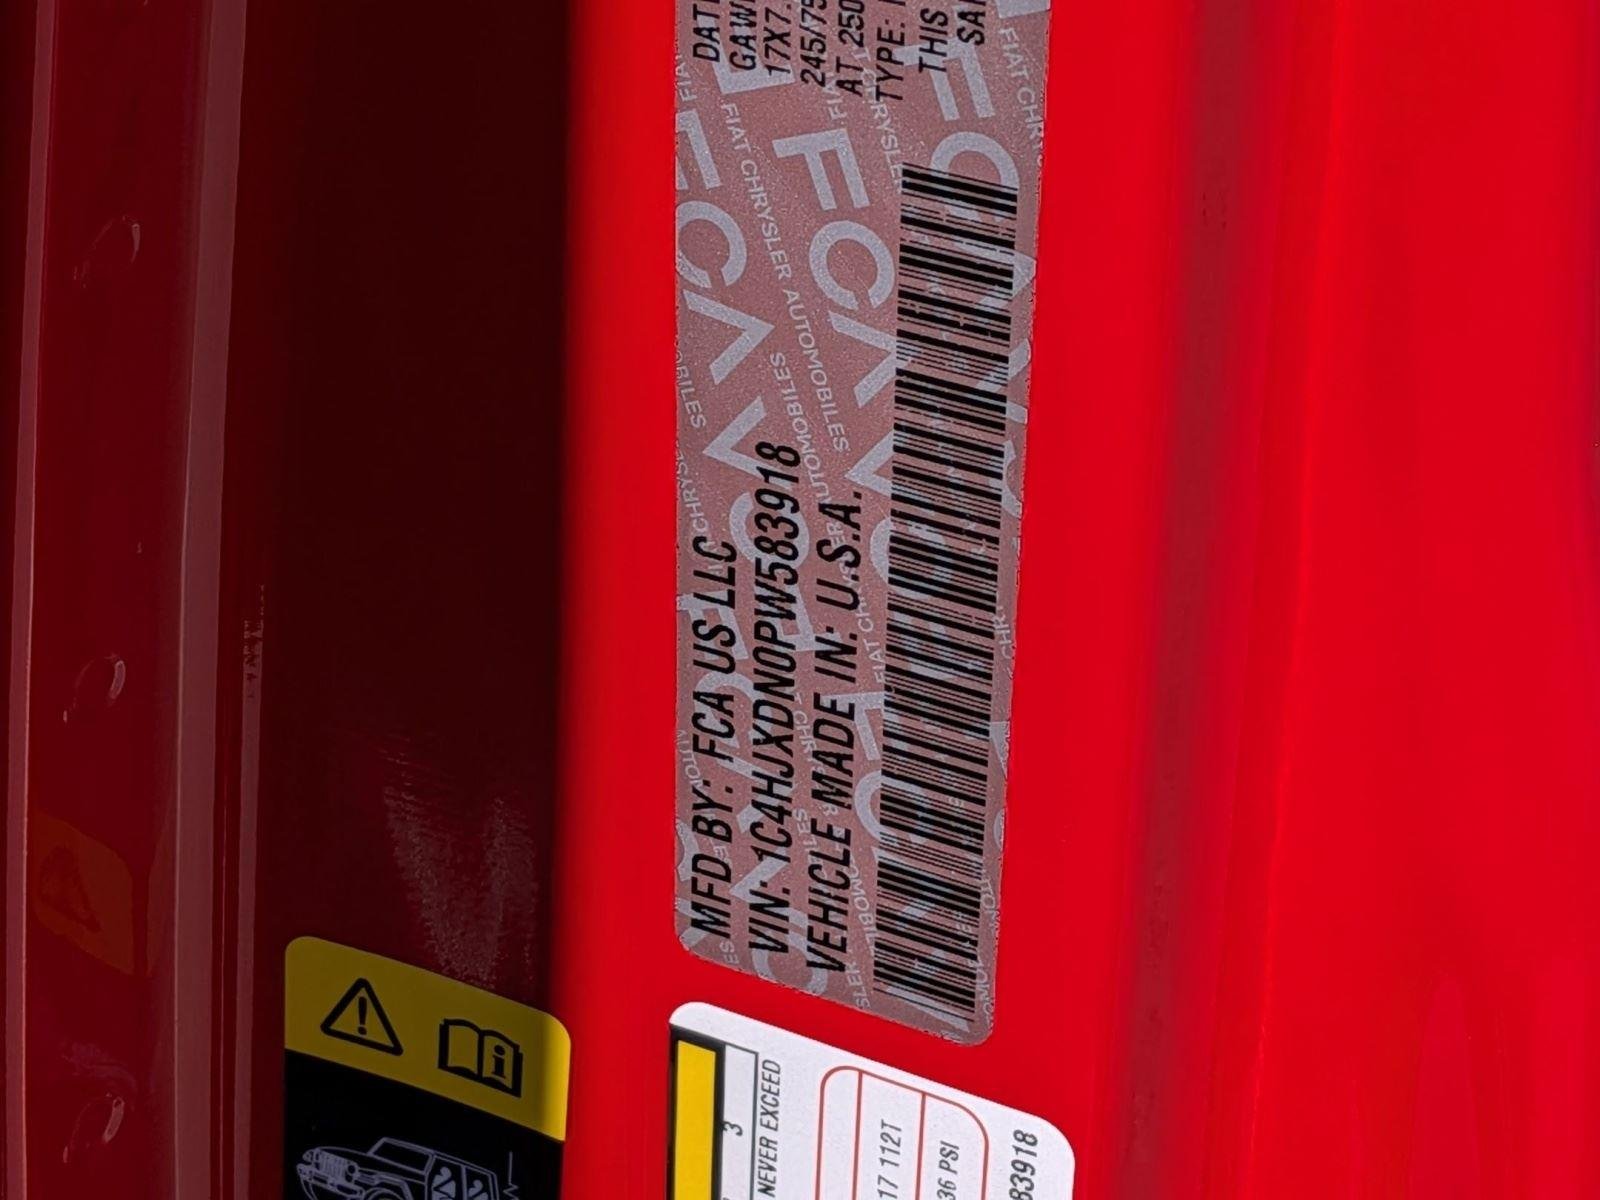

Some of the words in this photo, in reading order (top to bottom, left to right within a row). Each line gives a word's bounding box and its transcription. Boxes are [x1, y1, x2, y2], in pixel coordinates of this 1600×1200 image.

[692, 0, 720, 62] DAT
[729, 0, 757, 71] GAW
[919, 8, 949, 73] THIS
[956, 0, 986, 46] SA
[835, 56, 863, 97] AT
[876, 19, 906, 101] TYPE:
[720, 102, 752, 153] FIAT
[740, 159, 792, 280] CHRYSLER
[782, 289, 849, 453] AUTOMOBILES
[769, 352, 832, 504] UTOMOBILES
[692, 536, 737, 609] LLC
[816, 491, 862, 611] U.S.A.
[692, 619, 736, 674] US
[814, 626, 858, 684] IN:
[691, 690, 735, 763] FCA
[811, 692, 855, 810] MADE
[691, 779, 734, 843] BY:
[691, 853, 732, 939] MFD
[748, 880, 791, 953] VIN:
[806, 818, 851, 972] VEHICLE
[721, 1120, 743, 1137] 3
[759, 1059, 781, 1132] EXCEED
[758, 1136, 778, 1198] NEVER
[879, 1119, 902, 1167] 112T
[938, 1141, 960, 1174] PSI
